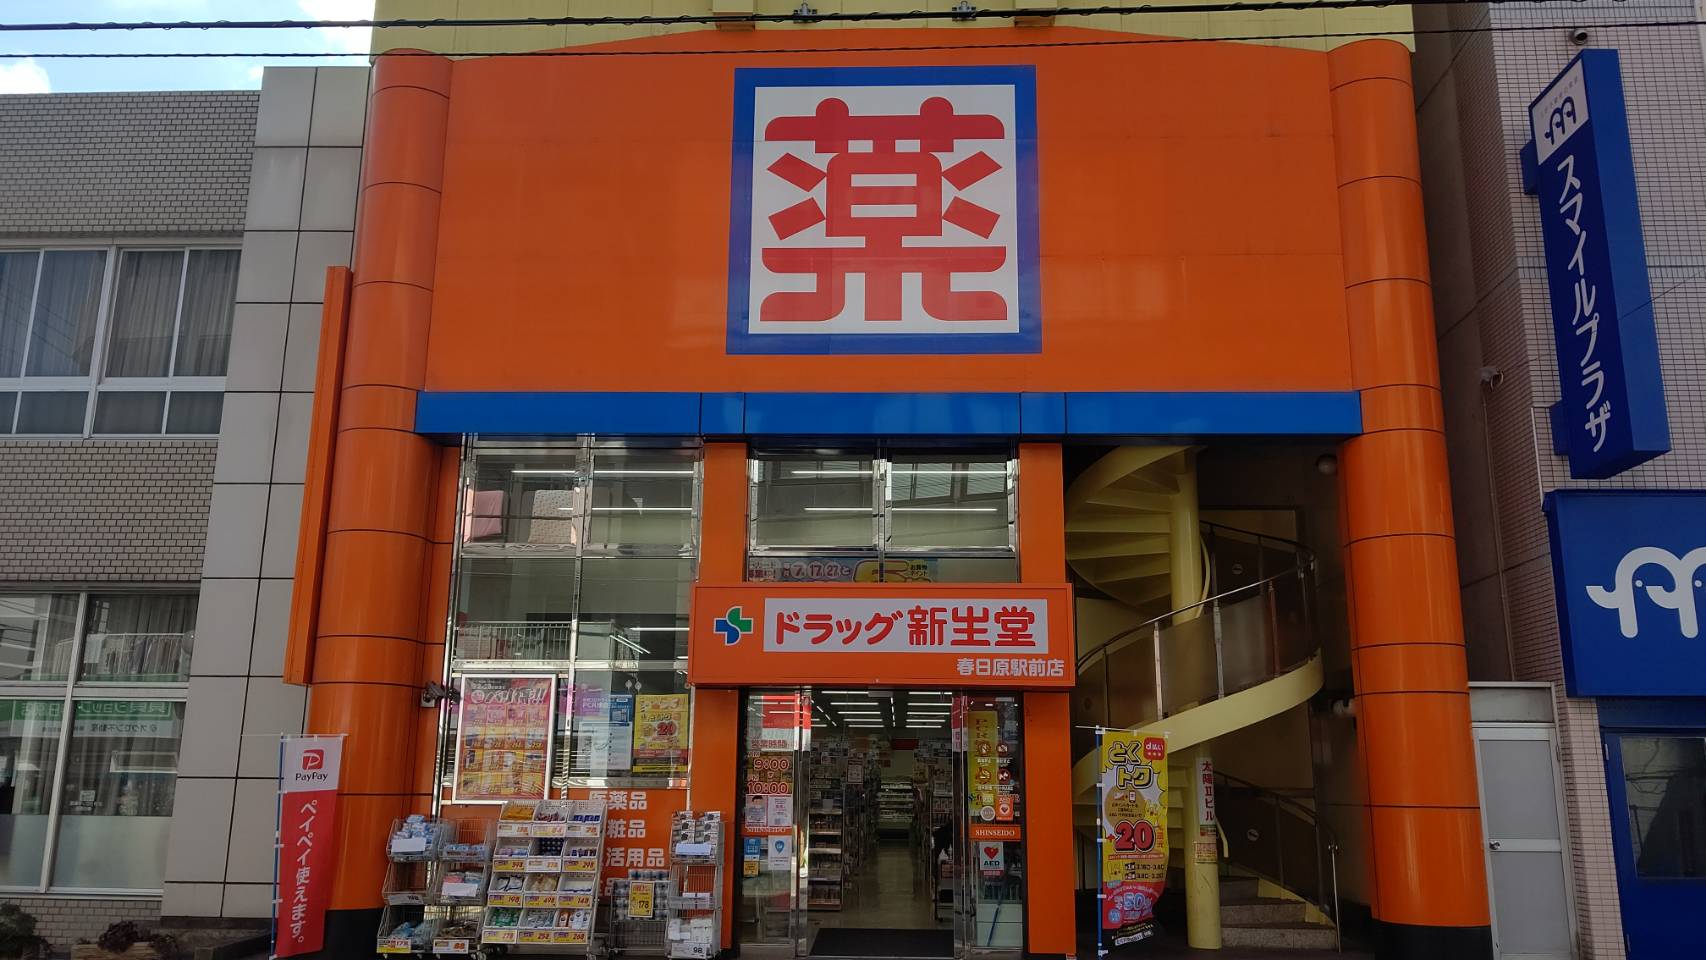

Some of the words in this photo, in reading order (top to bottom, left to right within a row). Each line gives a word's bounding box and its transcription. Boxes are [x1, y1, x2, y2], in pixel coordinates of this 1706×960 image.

[760, 97, 1007, 321] 薬
[1557, 153, 1611, 452] スマイルプラザ
[775, 605, 1036, 647] ドラッグ新生堂
[956, 657, 1064, 677] 春日原駅前店
[1109, 741, 1142, 765] とく
[295, 771, 328, 782] PayPay
[1116, 765, 1153, 790] トク
[638, 900, 649, 909] 178
[692, 946, 703, 954] 98
